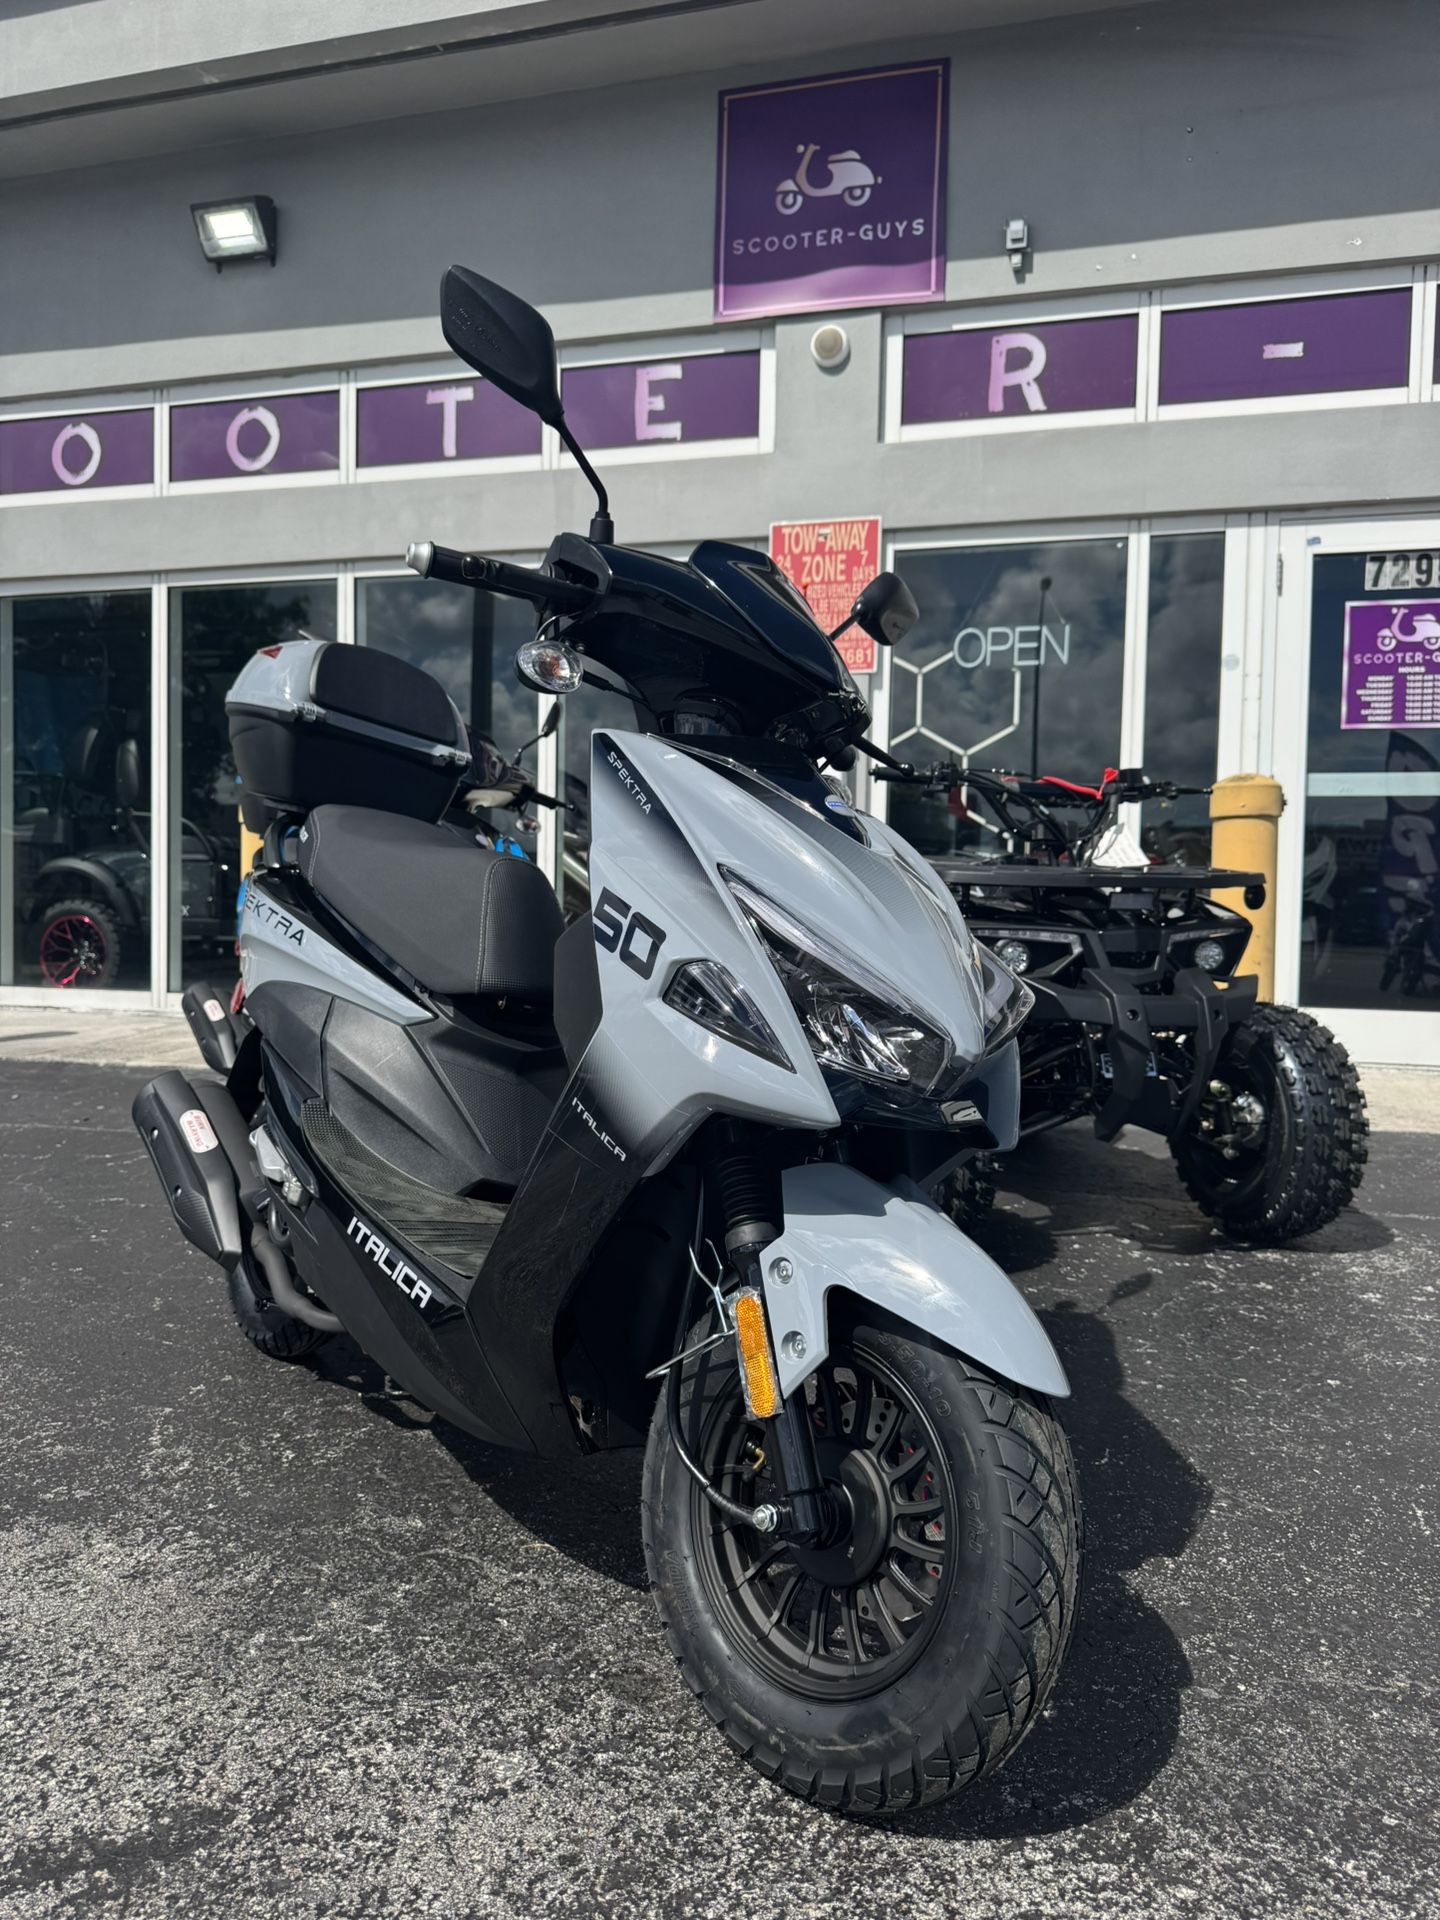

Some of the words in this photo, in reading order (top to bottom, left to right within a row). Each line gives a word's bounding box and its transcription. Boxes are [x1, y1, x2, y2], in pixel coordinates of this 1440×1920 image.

[732, 218, 926, 256] SCOOTER-GUYS
[801, 553, 847, 584] ZONE
[860, 551, 870, 566] 7
[852, 566, 875, 581] DAYS
[1369, 553, 1440, 587] 729
[953, 624, 1071, 669] OPEN
[607, 751, 651, 815] SPEKTRA
[593, 886, 667, 981] 50
[572, 1097, 626, 1162] ITALICA
[347, 1216, 433, 1310] ITALICA
